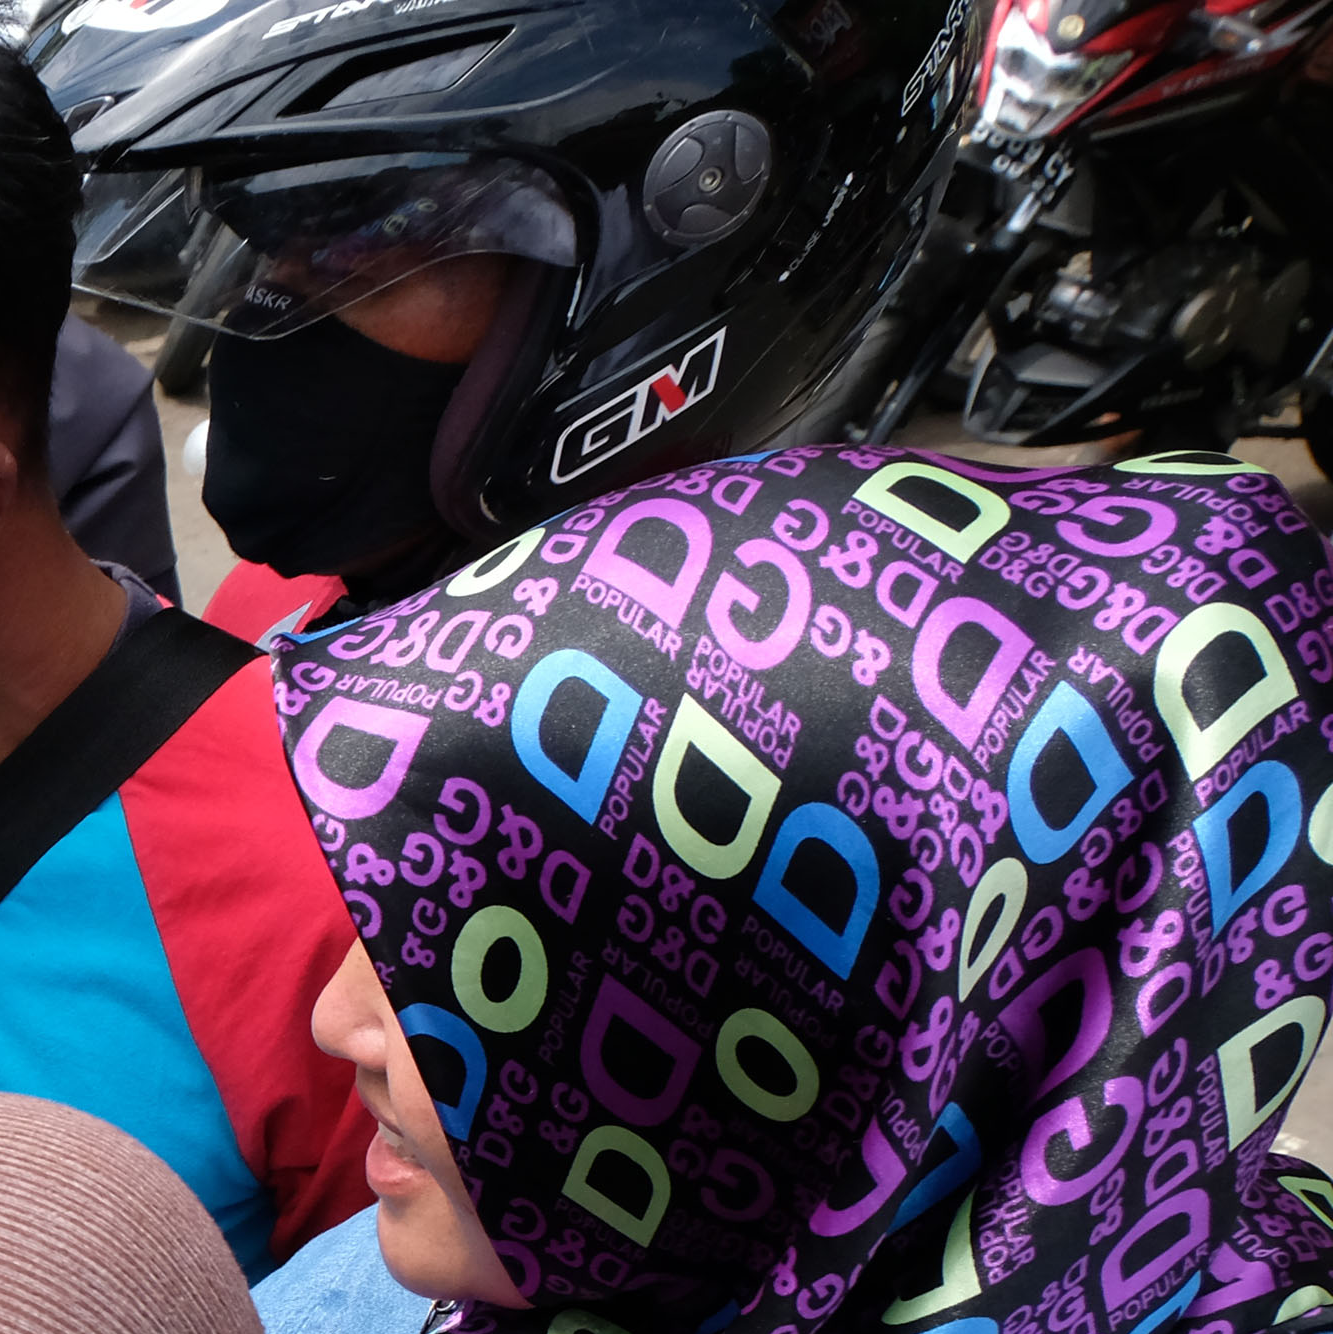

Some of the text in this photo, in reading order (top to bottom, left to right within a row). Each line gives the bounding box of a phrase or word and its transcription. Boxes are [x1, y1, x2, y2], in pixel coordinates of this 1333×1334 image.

[550, 326, 727, 484] GM
[582, 498, 714, 630] D
[840, 500, 965, 584] POPULAR
[852, 461, 1011, 564] D
[568, 570, 683, 661] POPULAR
[705, 538, 812, 671] G
[336, 673, 441, 711] POPULAR
[693, 633, 803, 744] POPULAR
[911, 596, 1035, 751] D
[973, 649, 1057, 773] POPULAR
[1067, 647, 1166, 764] POPULAR
[1153, 602, 1300, 782] D
[510, 649, 643, 826] D
[598, 697, 669, 841] POPULAR
[652, 692, 783, 880] D
[1194, 700, 1312, 808] POPULAR
[752, 801, 881, 981] D
[452, 905, 548, 1033] O
[741, 914, 847, 1018] POPULAR
[715, 1007, 820, 1122] O
[1196, 1054, 1229, 1174] POPULAR
[560, 1124, 673, 1249] D
